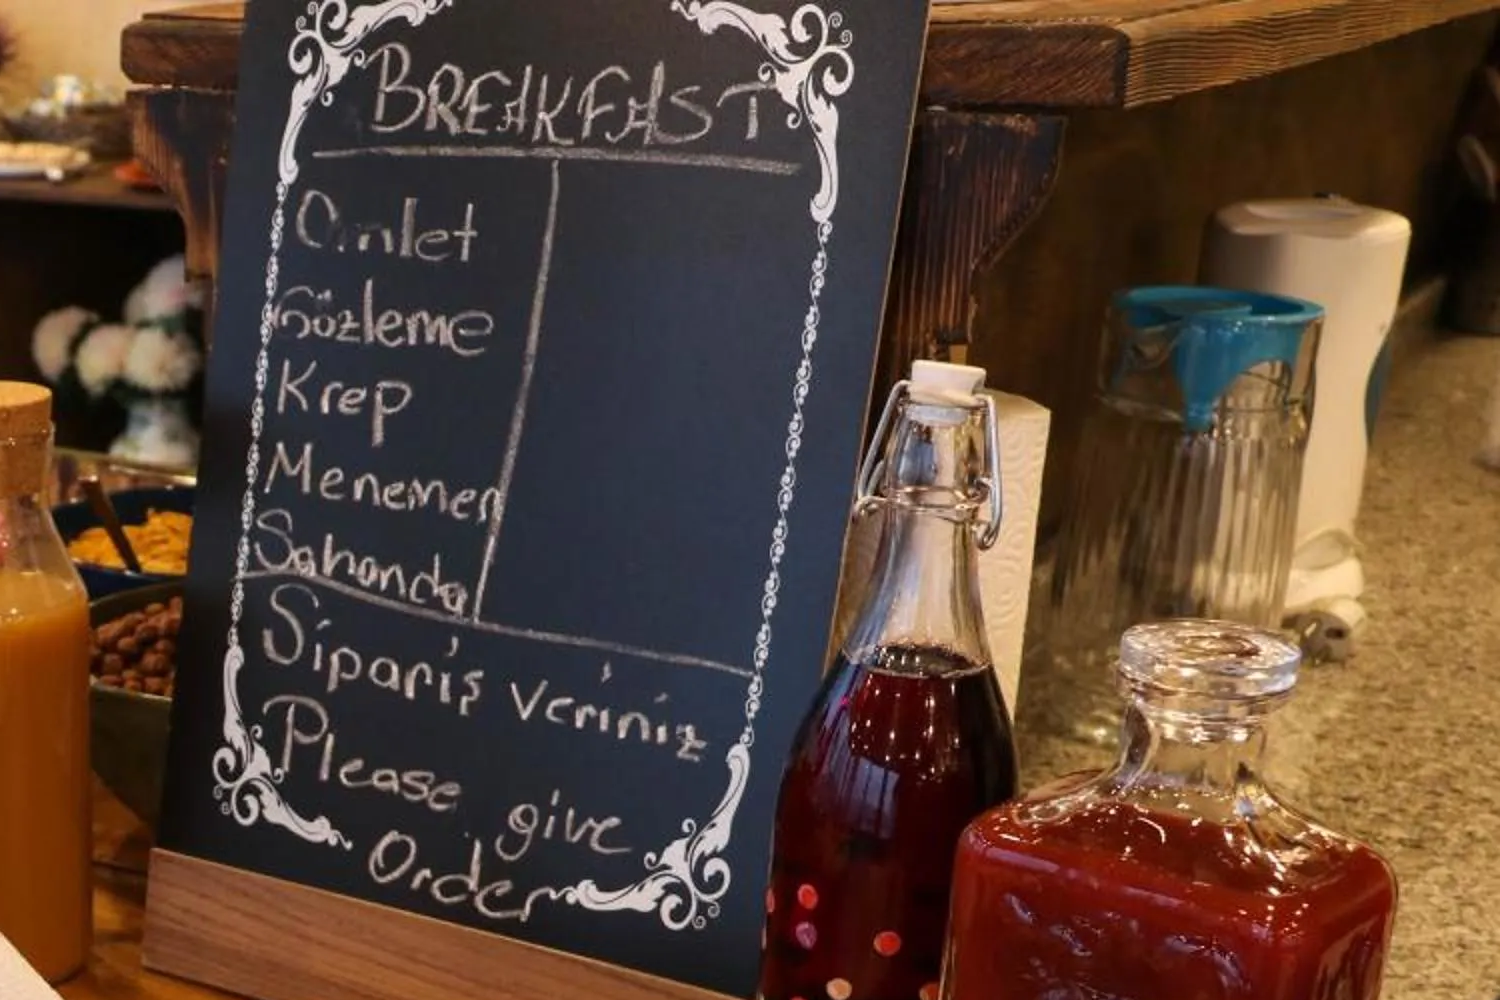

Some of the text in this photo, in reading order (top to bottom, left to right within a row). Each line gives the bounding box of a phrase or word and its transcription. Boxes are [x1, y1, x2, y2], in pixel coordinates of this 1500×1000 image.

[362, 42, 778, 146] BREAKFAST
[276, 360, 412, 447] Krep
[263, 440, 502, 524] Menemen
[252, 507, 470, 618] Sahanda
[262, 694, 633, 862] Please give
[368, 830, 562, 923] Order
